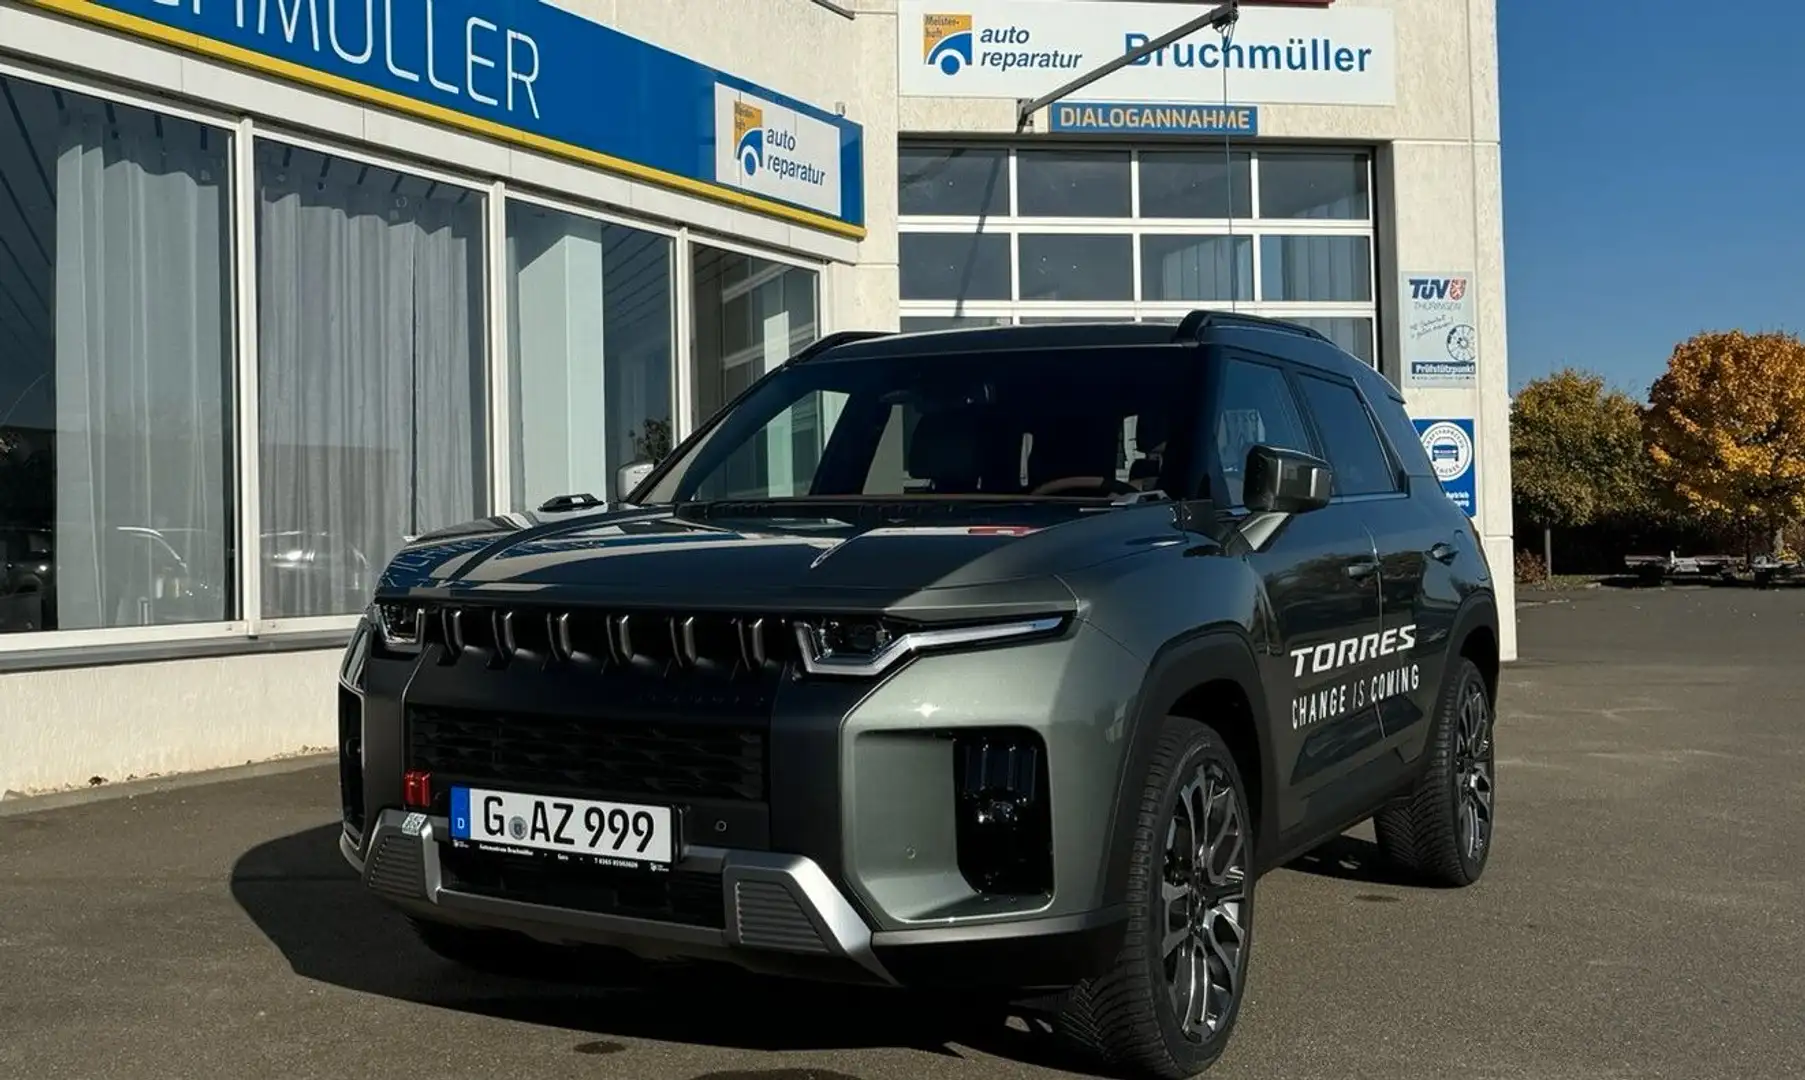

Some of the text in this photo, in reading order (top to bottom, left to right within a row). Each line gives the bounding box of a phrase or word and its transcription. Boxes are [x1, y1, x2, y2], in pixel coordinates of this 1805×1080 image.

[980, 26, 1030, 45] auto
[980, 50, 1083, 72] reparatur
[1124, 33, 1372, 72] Bruchmüller
[1060, 106, 1251, 129] DIALOGANNAHME
[766, 128, 796, 152] auto
[766, 154, 826, 186] reparatur
[1290, 624, 1417, 678] TORRES
[1292, 664, 1420, 730] CHANGE IS COMING
[457, 817, 466, 829] D
[483, 795, 655, 853] G AZ 999
